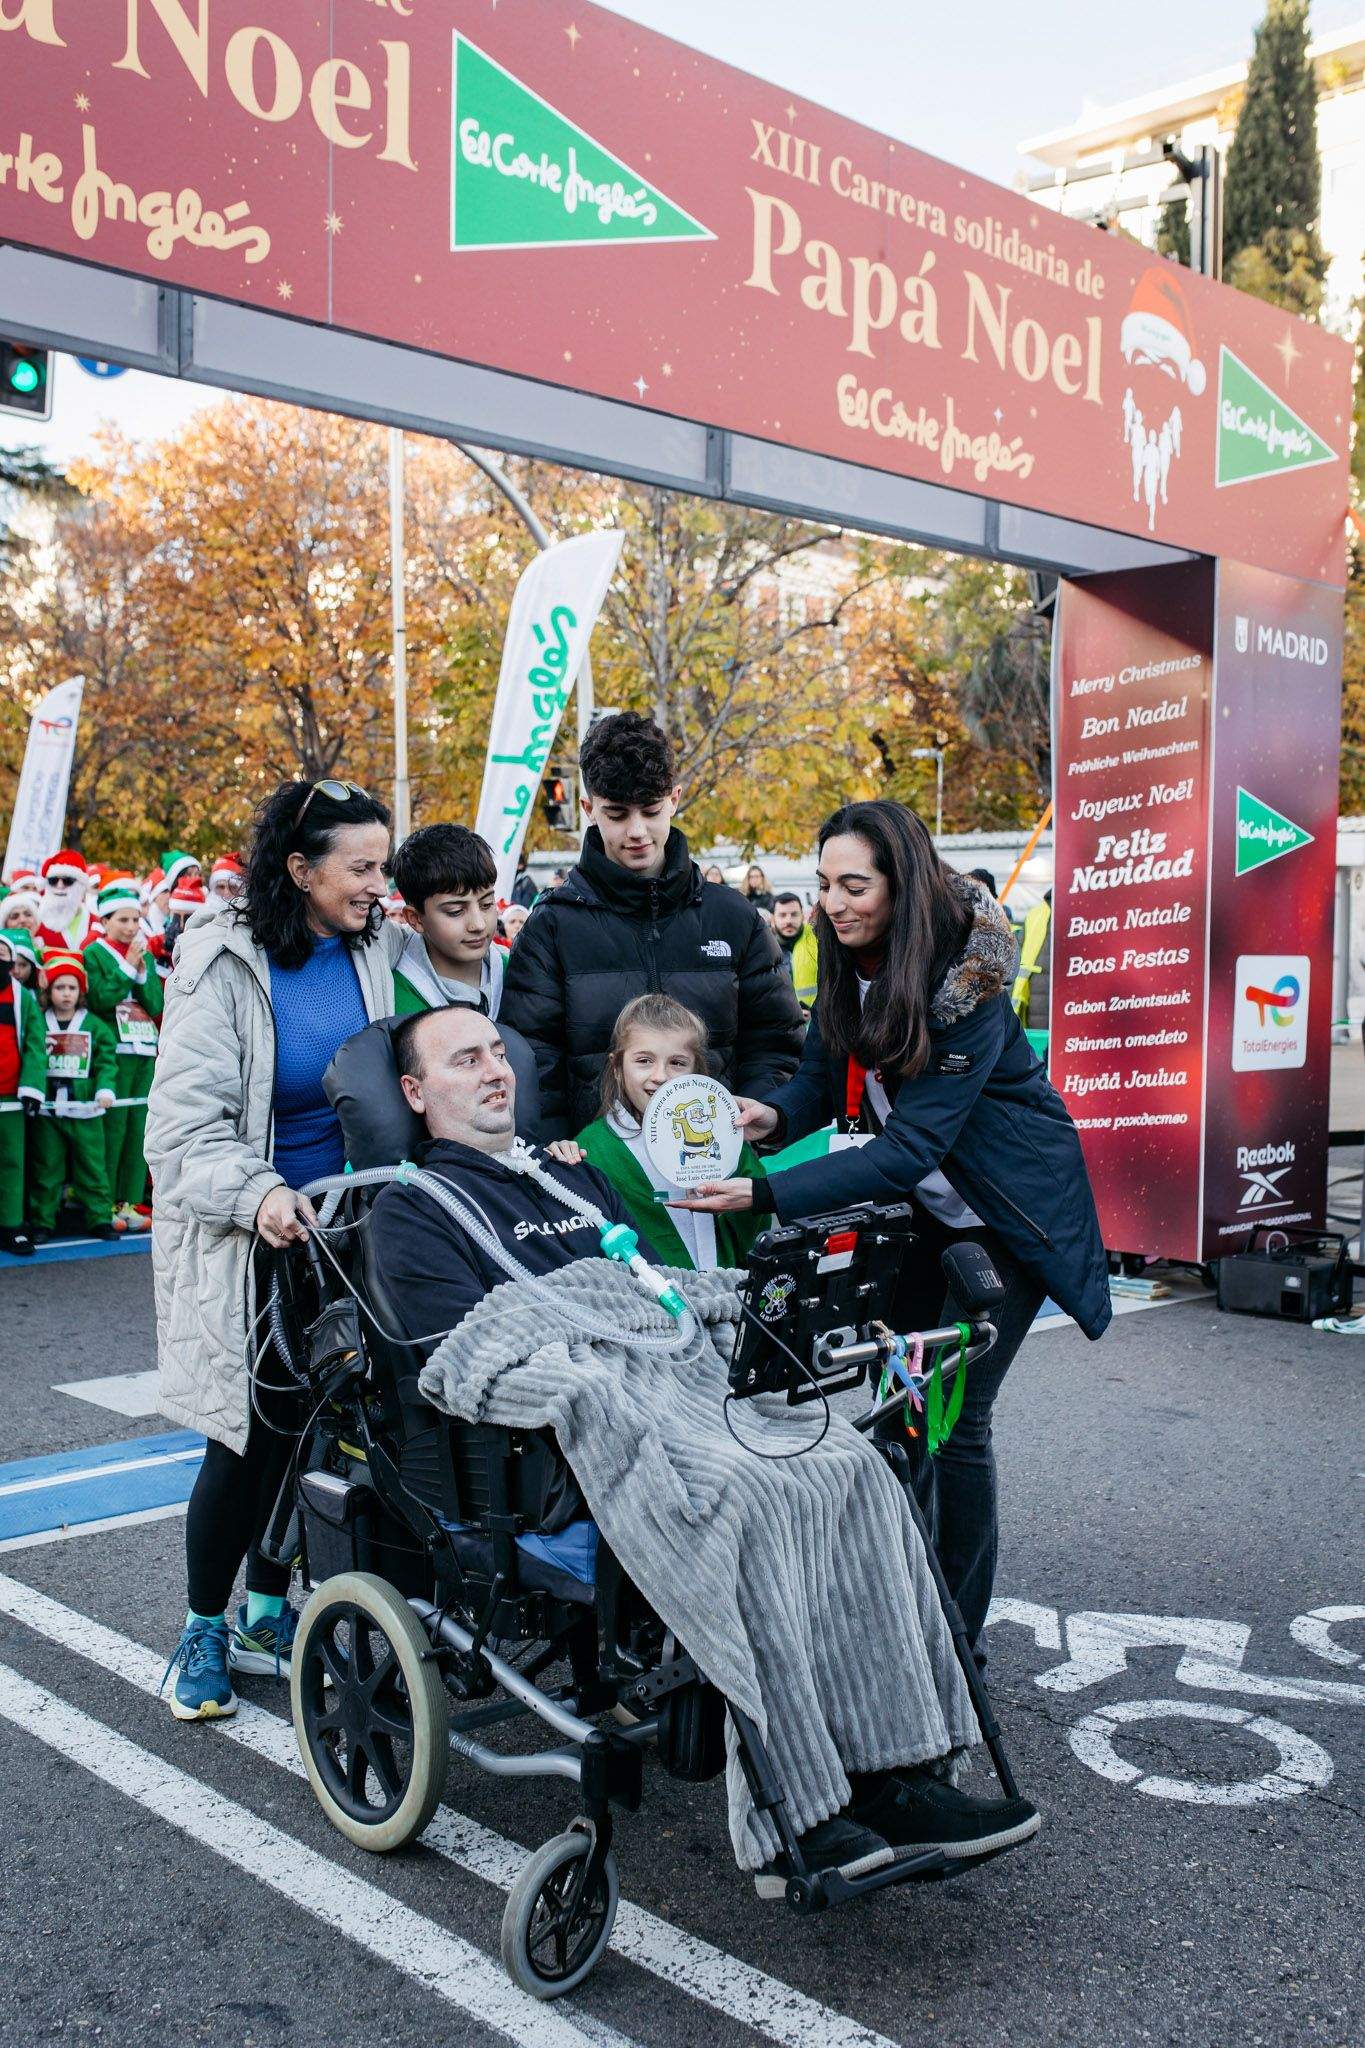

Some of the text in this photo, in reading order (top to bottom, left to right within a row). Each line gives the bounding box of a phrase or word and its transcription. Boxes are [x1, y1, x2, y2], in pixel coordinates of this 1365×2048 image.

[112, 0, 418, 172] Noel
[460, 118, 657, 225] El Corte Inglés
[71, 123, 271, 263] Inglés
[750, 119, 1104, 299] XIII Carrera solidaria de
[743, 186, 1103, 406] Papá Noel
[837, 373, 1035, 482] El Corte Inglés
[1258, 624, 1328, 666] MADRID
[1070, 654, 1201, 697] Merry Christmas
[1081, 695, 1188, 739] Bon Nadal
[1122, 739, 1200, 764] Weihnachten
[1071, 778, 1194, 821] Joyeux Noël
[1094, 828, 1167, 863] Feliz
[1069, 848, 1194, 894] Navidad
[1067, 902, 1191, 937] Buon Natale
[1066, 947, 1190, 976] Boas Festas
[1064, 989, 1191, 1015] Gabon Zoriontsuak
[1064, 1029, 1188, 1053] Shinnen omedeto
[1243, 1040, 1297, 1054] TotalEnergies
[651, 1096, 667, 1125] Carrera
[665, 1089, 674, 1098] de
[692, 1079, 708, 1089] Noel
[709, 1084, 718, 1094] El
[718, 1091, 732, 1111] Corte
[1063, 1067, 1188, 1096] Hyvää Joulua
[1236, 1141, 1295, 1171] Reebok
[976, 1269, 1003, 1289] JBL
